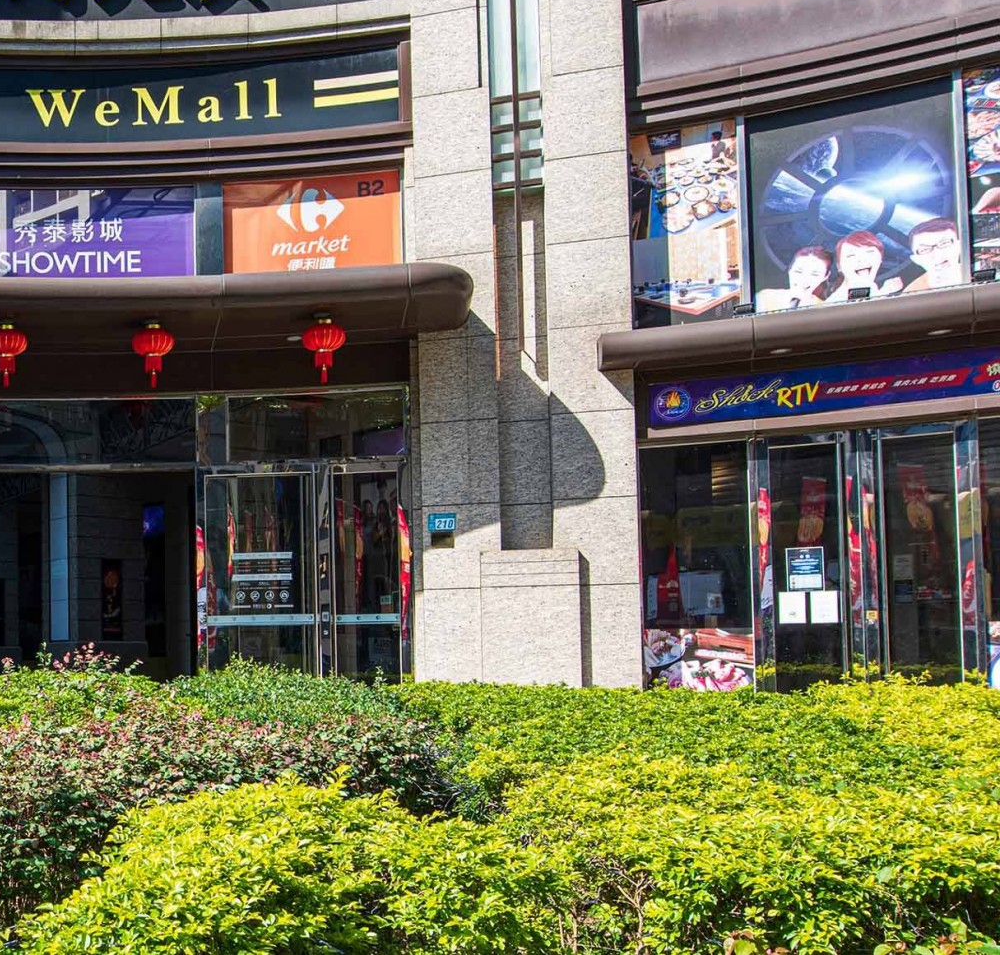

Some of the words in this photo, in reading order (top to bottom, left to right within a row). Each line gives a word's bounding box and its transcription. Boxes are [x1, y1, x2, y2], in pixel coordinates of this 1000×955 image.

[25, 78, 282, 128] WeMall
[357, 180, 384, 197] B2
[14, 218, 123, 245] 秀泰影城
[272, 235, 350, 256] market
[776, 380, 820, 408] RTV
[436, 519, 454, 529] 210
